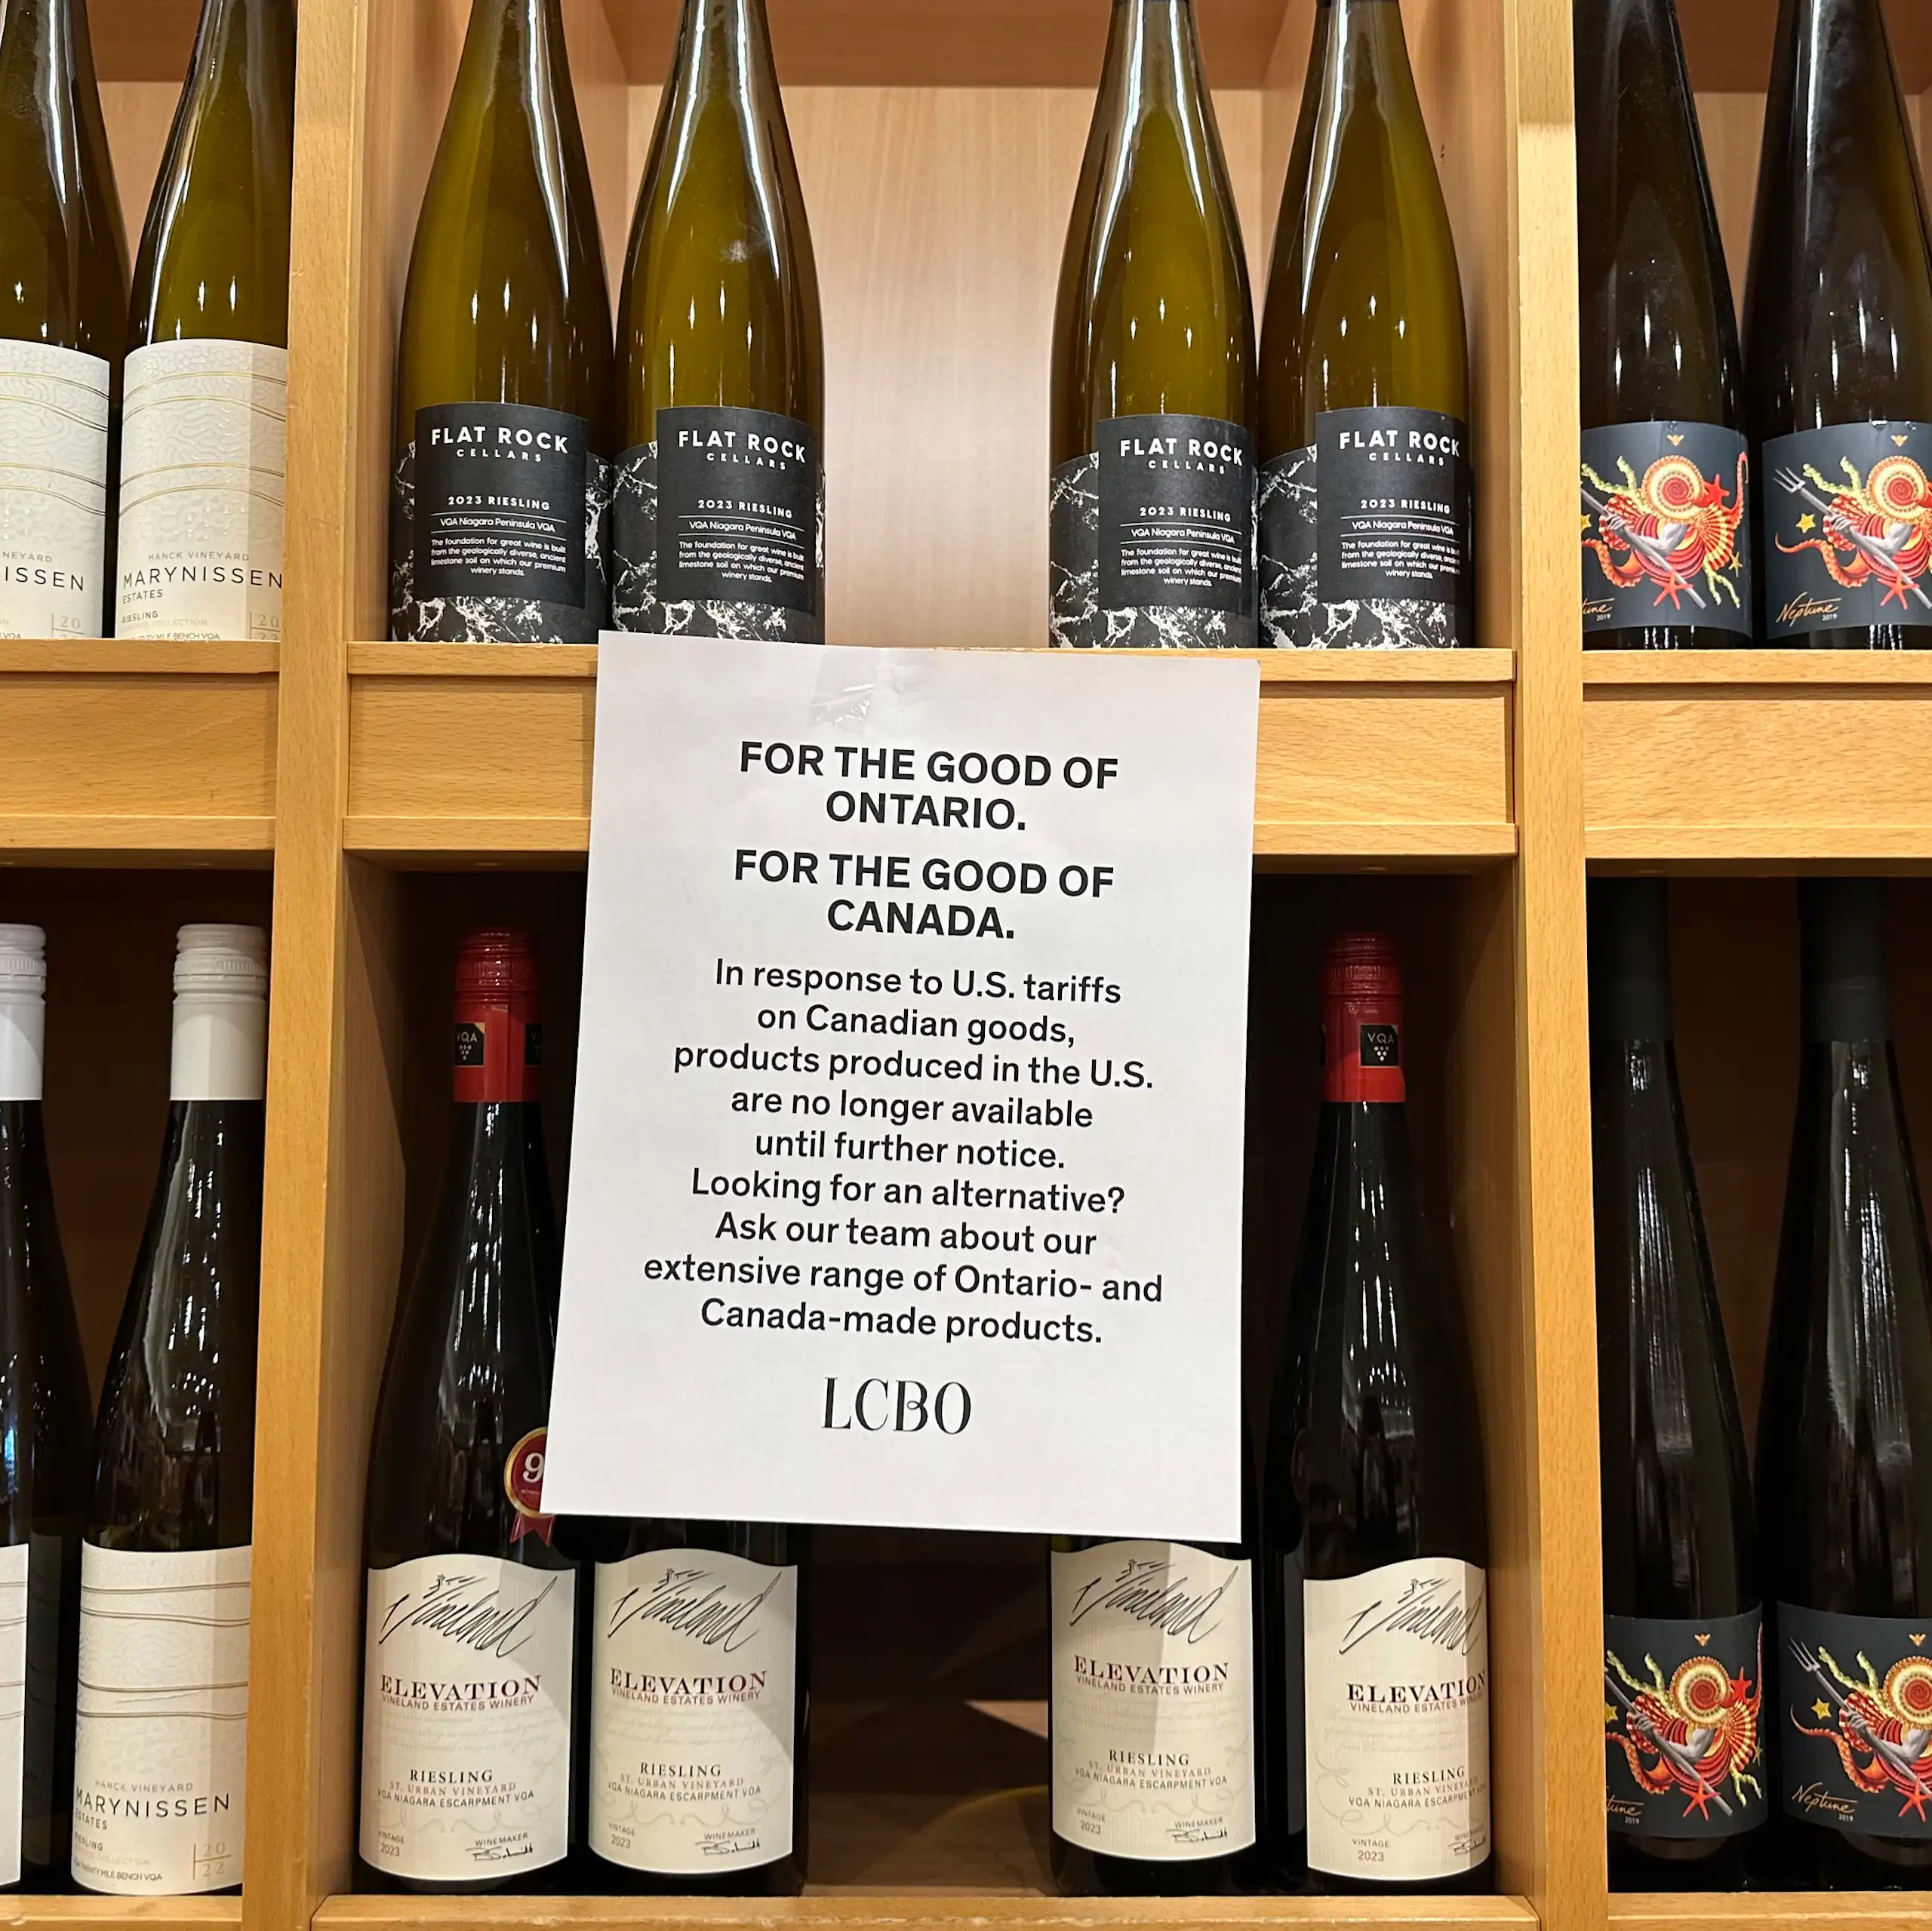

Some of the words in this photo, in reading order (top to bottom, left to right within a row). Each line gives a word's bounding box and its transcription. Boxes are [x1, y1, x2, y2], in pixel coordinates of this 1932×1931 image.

[432, 427, 485, 444] FLAT
[499, 428, 568, 454] ROCK
[679, 431, 736, 447] FLAT
[748, 434, 804, 464] ROCK
[1340, 430, 1398, 449] FLAT
[1410, 431, 1459, 458] ROCK
[457, 449, 541, 462] CELLARS
[707, 452, 786, 469] CELLARS
[1121, 438, 1177, 457] FLAT
[1189, 439, 1242, 467] ROCK
[1369, 453, 1443, 466] CELLARS
[1149, 460, 1224, 474] CELLARS
[448, 496, 481, 505] 2023
[488, 497, 549, 510] RIESLING
[698, 500, 732, 509] 2023
[737, 502, 792, 520] RIESLING
[1361, 499, 1395, 509] 2023
[1401, 500, 1450, 514] RIESLING
[1140, 507, 1174, 515] 2023
[1180, 507, 1230, 521] RIESLING
[441, 518, 458, 526] VQA
[460, 518, 494, 527] Niagara
[495, 518, 536, 530] Peninsula
[537, 522, 555, 532] VQA
[710, 521, 743, 531] Niagara
[744, 522, 782, 539] Peninsula
[782, 530, 795, 540] VQA
[149, 552, 182, 560] HANCK
[189, 550, 250, 561] VINEYARD
[462, 548, 508, 557] geologically
[509, 549, 539, 559] diverse,
[540, 553, 566, 563] ancient
[500, 540, 521, 548] great
[551, 544, 565, 553] built
[3, 552, 52, 562] NEYARD
[471, 567, 497, 575] winery
[534, 563, 565, 572] premium
[125, 567, 281, 589] MARYNISSEN
[123, 589, 162, 604] ESTATES
[122, 611, 158, 623] RIESLING
[1777, 592, 1841, 626] Neptune
[258, 615, 279, 629] 20
[741, 741, 823, 776] FOR
[835, 746, 915, 779] THE
[928, 752, 1051, 789] GOOD
[1064, 757, 1118, 789] OF
[827, 791, 1025, 834] ONTARIO.
[736, 850, 818, 884] FOR
[829, 854, 909, 888] THE
[923, 859, 1046, 897] GOOD
[1060, 866, 1113, 897] OF
[828, 899, 1014, 939] CANADA.
[717, 958, 743, 985] In
[755, 963, 900, 1003] response
[910, 969, 942, 995] to
[954, 970, 1014, 998] U.S.
[1024, 974, 1121, 1007] tariffs
[758, 1006, 795, 1029] on
[807, 1004, 957, 1037] Canadian
[968, 1016, 1077, 1047] goods,
[1367, 1033, 1392, 1044] VQA
[675, 1043, 819, 1073] products
[829, 1050, 982, 1084] produced
[993, 1055, 1018, 1085] in
[1028, 1057, 1079, 1088] the
[1091, 1059, 1152, 1088] U.S.
[732, 1088, 782, 1117] are
[792, 1095, 830, 1119] no
[841, 1090, 943, 1125] longer
[952, 1097, 1092, 1131] available
[757, 1130, 825, 1161] until
[835, 1132, 948, 1166] further
[957, 1140, 1063, 1168] notice.
[693, 1168, 820, 1206] Looking
[830, 1174, 875, 1205] for
[884, 1179, 921, 1204] an
[932, 1179, 1124, 1216] alternative?
[715, 1212, 777, 1241] Ask
[786, 1222, 839, 1247] our
[846, 1219, 929, 1250] team
[940, 1222, 1034, 1252] about
[1044, 1229, 1097, 1254] our
[645, 1254, 800, 1289] extensive
[811, 1261, 903, 1299] range
[914, 1264, 946, 1291] of
[955, 1265, 1091, 1301] Ontario-
[1103, 1271, 1161, 1302] and
[702, 1298, 936, 1339] Canada-made
[946, 1311, 1101, 1347] products.
[824, 1378, 971, 1437] LCBO
[523, 1453, 545, 1483] 9
[1075, 1655, 1227, 1685] ELEVATION
[381, 1674, 540, 1702] ELEVATION
[611, 1668, 766, 1696] ELEVATION
[1077, 1674, 1125, 1691] VINELAND
[1131, 1681, 1179, 1694] ESTATES
[1183, 1680, 1223, 1694] WINERY
[1349, 1670, 1487, 1705] ELEVATION
[382, 1694, 429, 1709] VINELAND
[434, 1702, 485, 1711] ESTATES
[488, 1693, 534, 1708] WINERY
[613, 1687, 658, 1702] VINELAND
[664, 1696, 713, 1705] ESTATES
[717, 1689, 760, 1703] WINERY
[1351, 1700, 1410, 1713] VINELAND
[1415, 1699, 1457, 1712] ESTATES
[1110, 1749, 1188, 1765] RIESLING
[411, 1770, 491, 1783] RIESLING
[641, 1763, 720, 1777] RIESLING
[1394, 1766, 1463, 1786] RIESLING
[95, 1780, 126, 1791] HANCK
[132, 1783, 192, 1792] VINEYARD
[390, 1781, 405, 1790] ST.
[408, 1785, 445, 1797] URBAN
[453, 1781, 516, 1797] VINEYARD
[75, 1785, 229, 1819] MARYNISSEN
[377, 1788, 391, 1801] VQA
[395, 1794, 435, 1806] NIAGARA
[440, 1794, 510, 1807] ESCARPMENT
[515, 1790, 534, 1801] VQA
[1792, 1780, 1859, 1813] Neptune
[1081, 1820, 1100, 1834] 2023
[377, 1830, 404, 1846] VINTAGE
[475, 1832, 528, 1847] WINEMAKER
[612, 1834, 630, 1849] 2023
[202, 1842, 226, 1859] 20
[381, 1842, 399, 1856] 2023
[1358, 1850, 1383, 1862] 2023
[202, 1862, 225, 1878] 22
